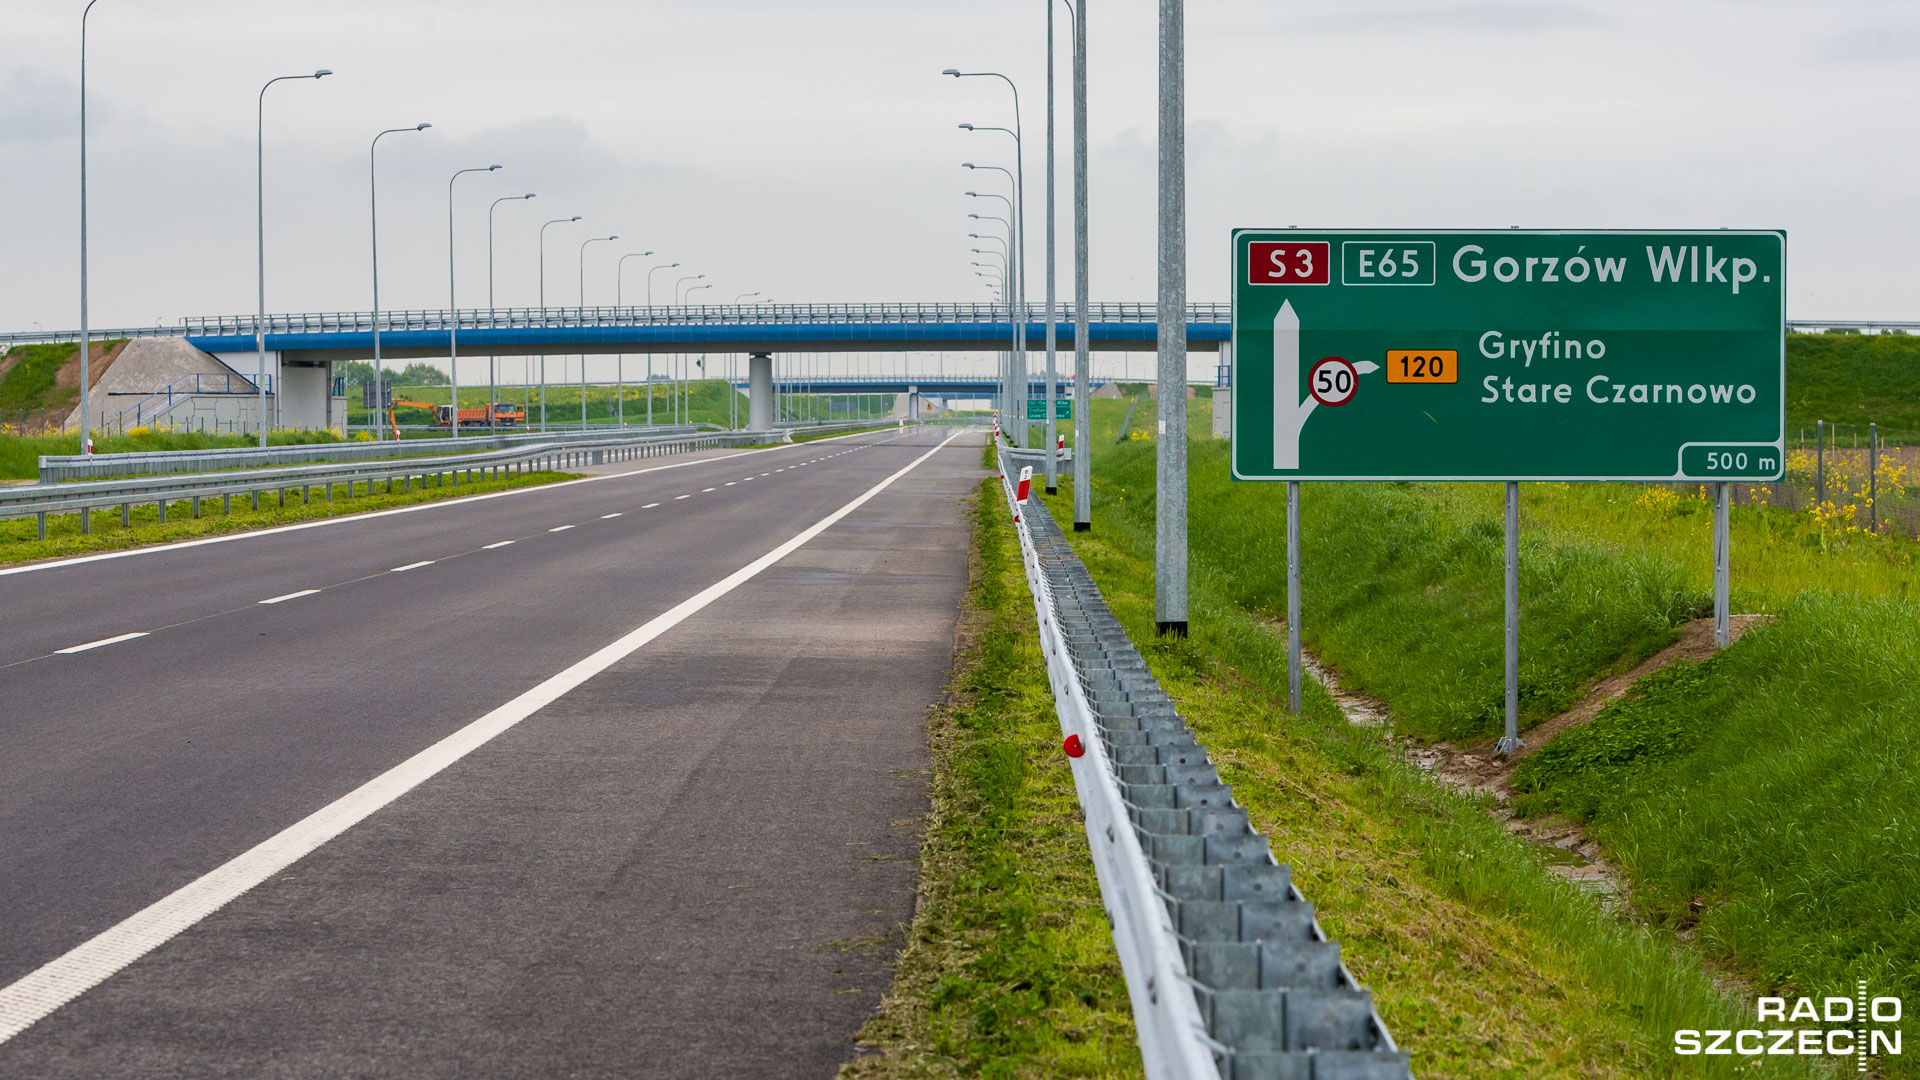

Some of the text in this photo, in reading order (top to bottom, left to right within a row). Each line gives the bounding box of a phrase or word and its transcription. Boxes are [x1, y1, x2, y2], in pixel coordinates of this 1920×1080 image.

[1359, 249, 1419, 277] E65
[1452, 245, 1771, 294] Gorzów Wlkp.
[1479, 331, 1606, 367] Gryfino
[1400, 356, 1444, 378] 120
[1317, 370, 1352, 394] 50
[1482, 375, 1756, 404] Stare Czarnowo
[1706, 453, 1776, 470] 500 m
